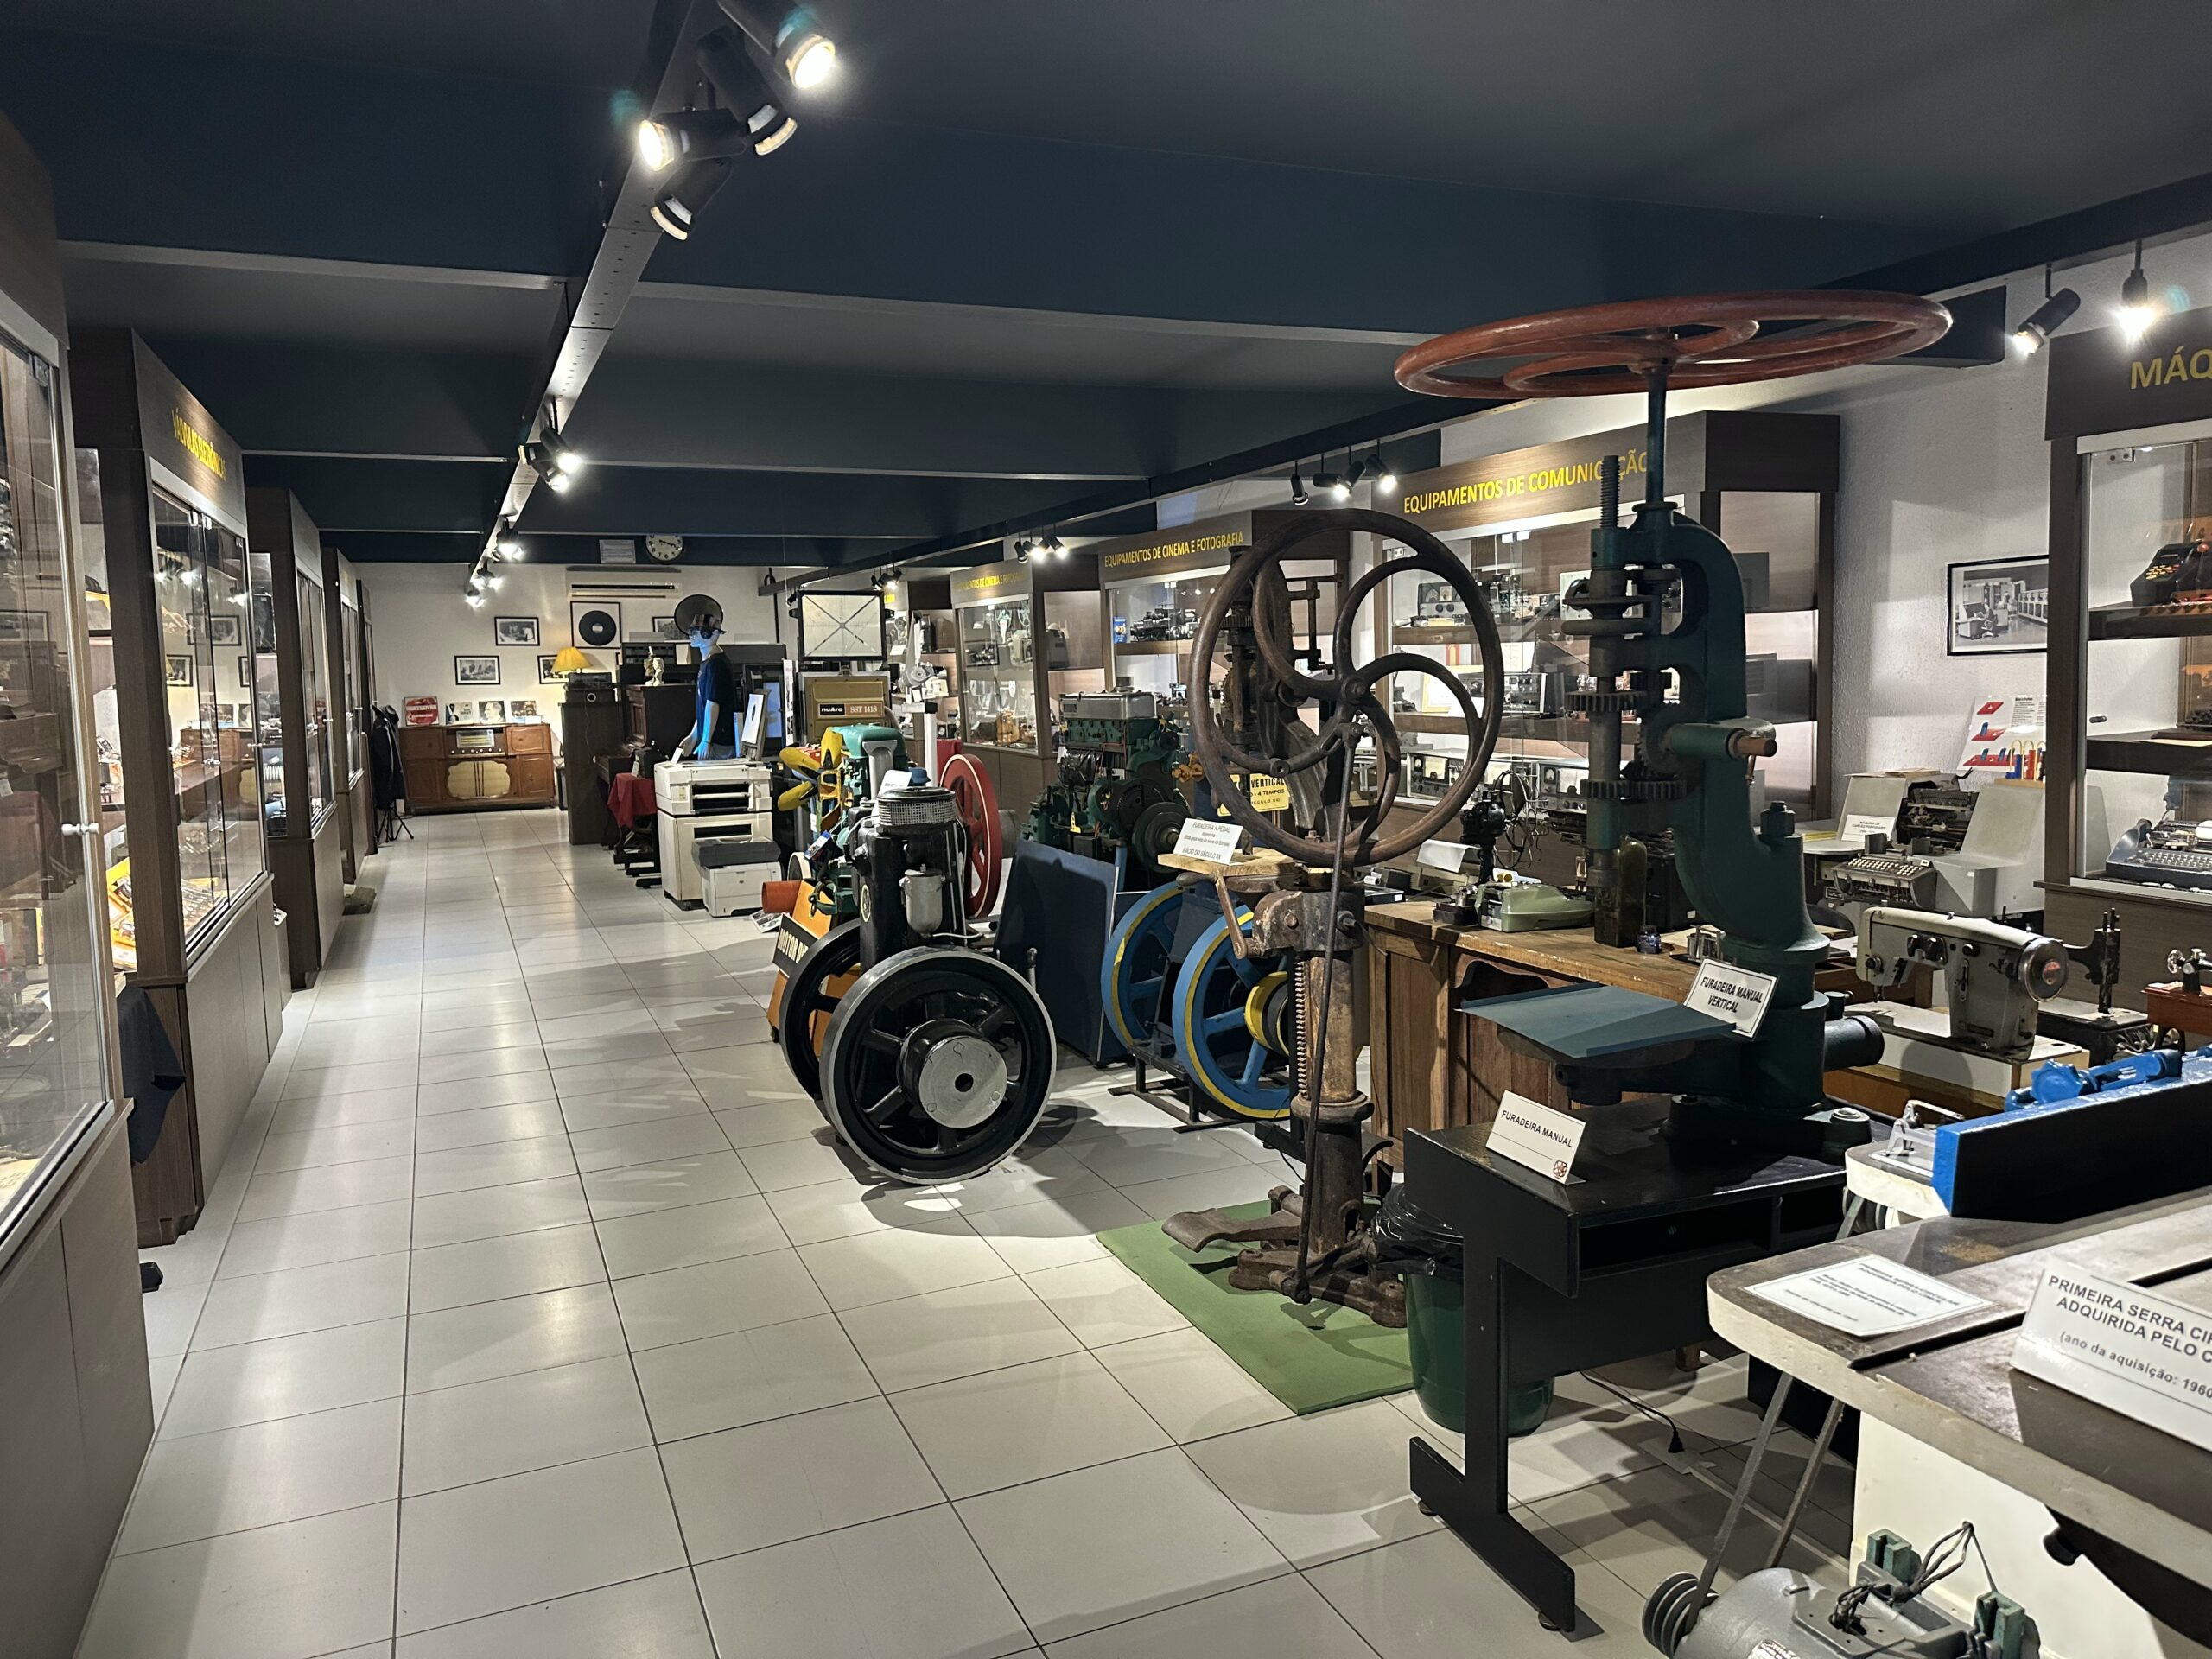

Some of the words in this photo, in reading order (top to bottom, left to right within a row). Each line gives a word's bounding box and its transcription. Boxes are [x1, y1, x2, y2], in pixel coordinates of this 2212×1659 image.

[1404, 479, 1503, 514] EQUIPAMENTOS
[1506, 475, 1525, 496] DE
[1528, 449, 1647, 492] COMUNICÇÃO
[1104, 548, 1152, 568] EQUIPAMENTOS
[1153, 546, 1161, 560] DE
[1162, 541, 1190, 558] CINEMA
[1191, 540, 1196, 553] E
[1197, 531, 1244, 552] FOTOGRAFIA
[1251, 778, 1285, 788] VERTICAL
[1700, 976, 1736, 995] FURADEIRA
[1736, 986, 1764, 1003] MANUAL
[1707, 995, 1738, 1013] VERTICAL
[1502, 1110, 1541, 1134] FURADEIRA
[1542, 1127, 1573, 1147] MANUAL
[2048, 1275, 2123, 1312] PRIMEIRA
[2127, 1304, 2185, 1334] SERRA
[2056, 1297, 2145, 1338] ADQUIRIDA
[2150, 1330, 2196, 1357] PELO
[2059, 1331, 2088, 1350] (ano
[2091, 1344, 2107, 1357] da
[2109, 1351, 2178, 1384] aquisição:
[2183, 1378, 2212, 1399] 1960
